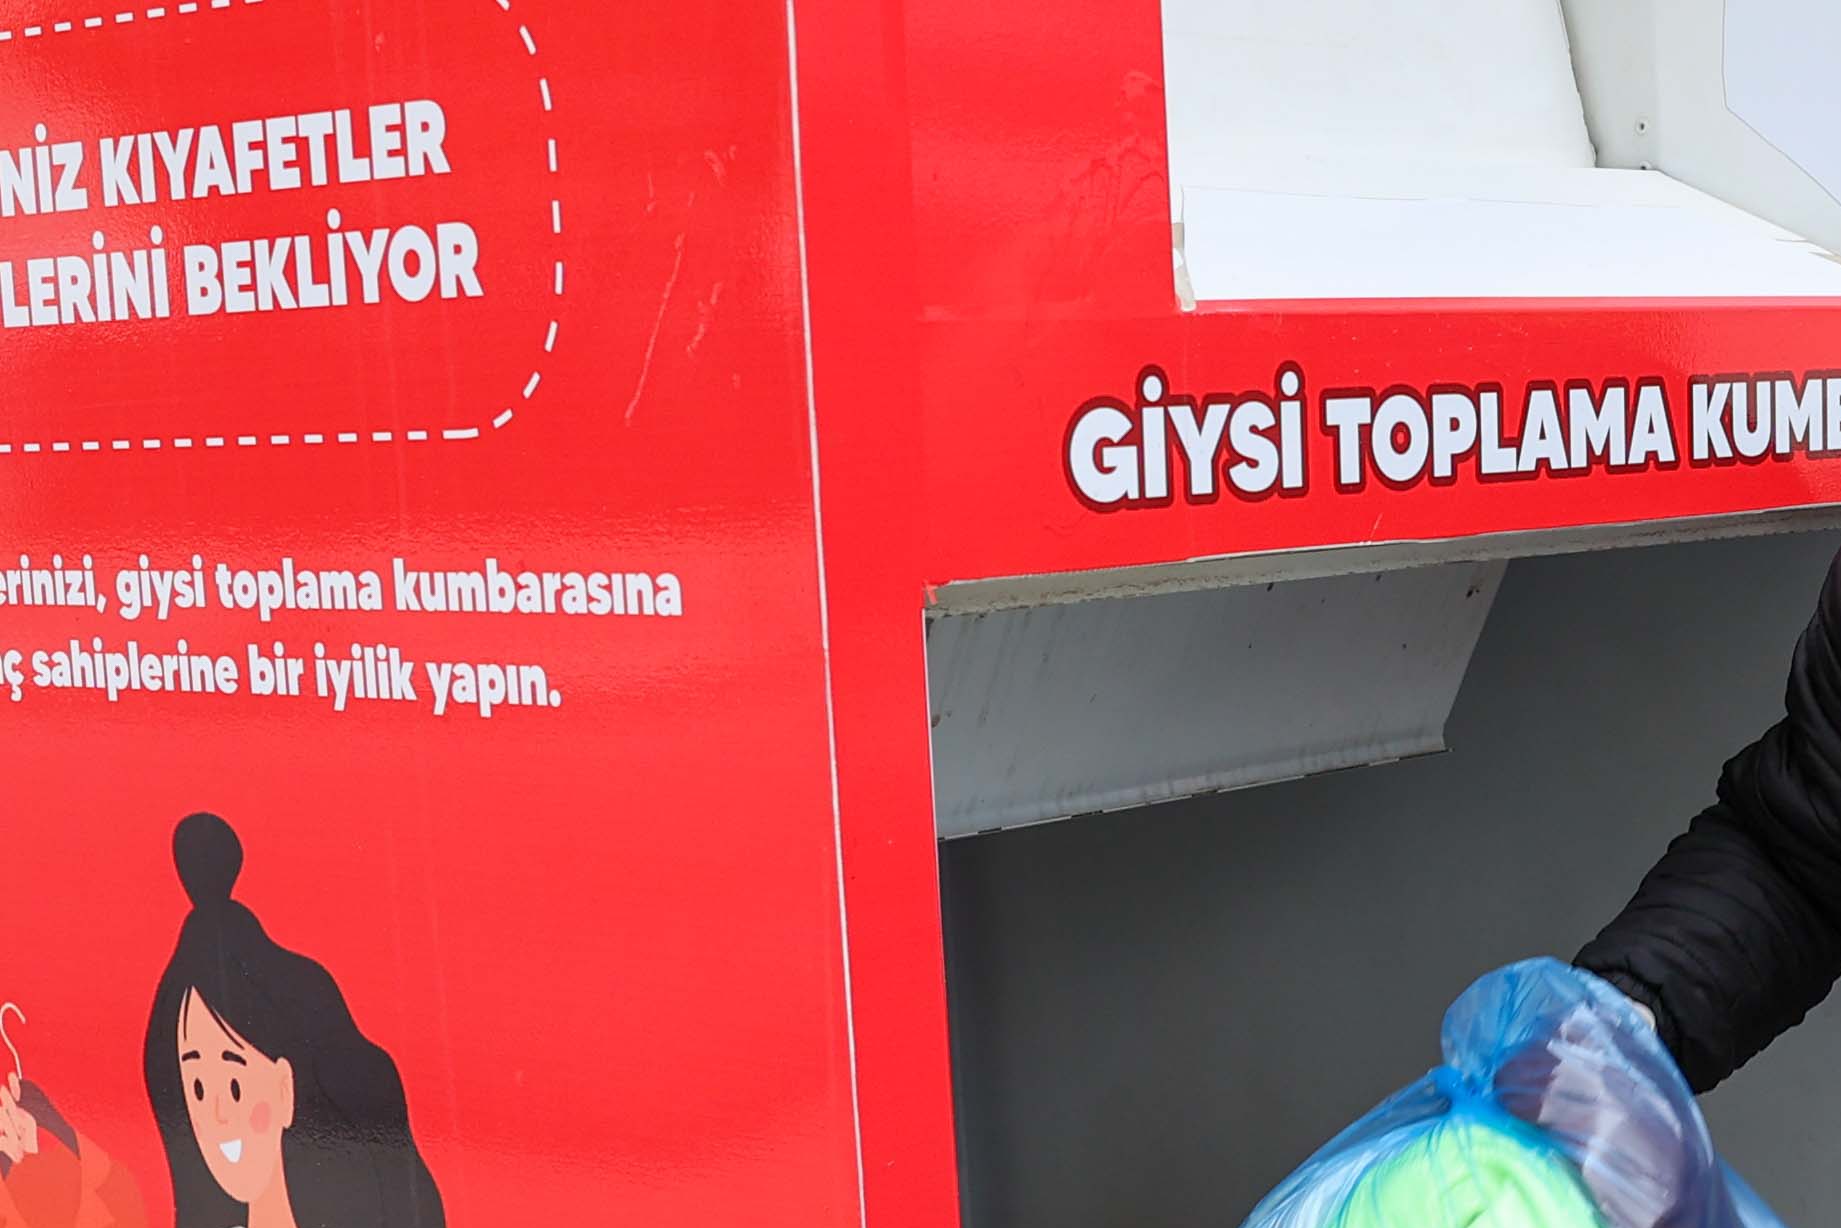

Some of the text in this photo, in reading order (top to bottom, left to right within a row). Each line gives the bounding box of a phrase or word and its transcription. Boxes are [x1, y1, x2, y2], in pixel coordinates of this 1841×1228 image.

[0, 99, 451, 216] NİZ KIYAFETLER
[0, 208, 484, 328] LERİNİ BEKLİYOR
[1069, 371, 1304, 503] GİYSİ
[1326, 384, 1675, 484] TOPLAMA
[116, 555, 205, 620] giysi
[215, 558, 383, 621] toplama
[392, 558, 683, 617] kumbarasına
[0, 637, 562, 717] ç sahiplerine bir iyilik yapın.
